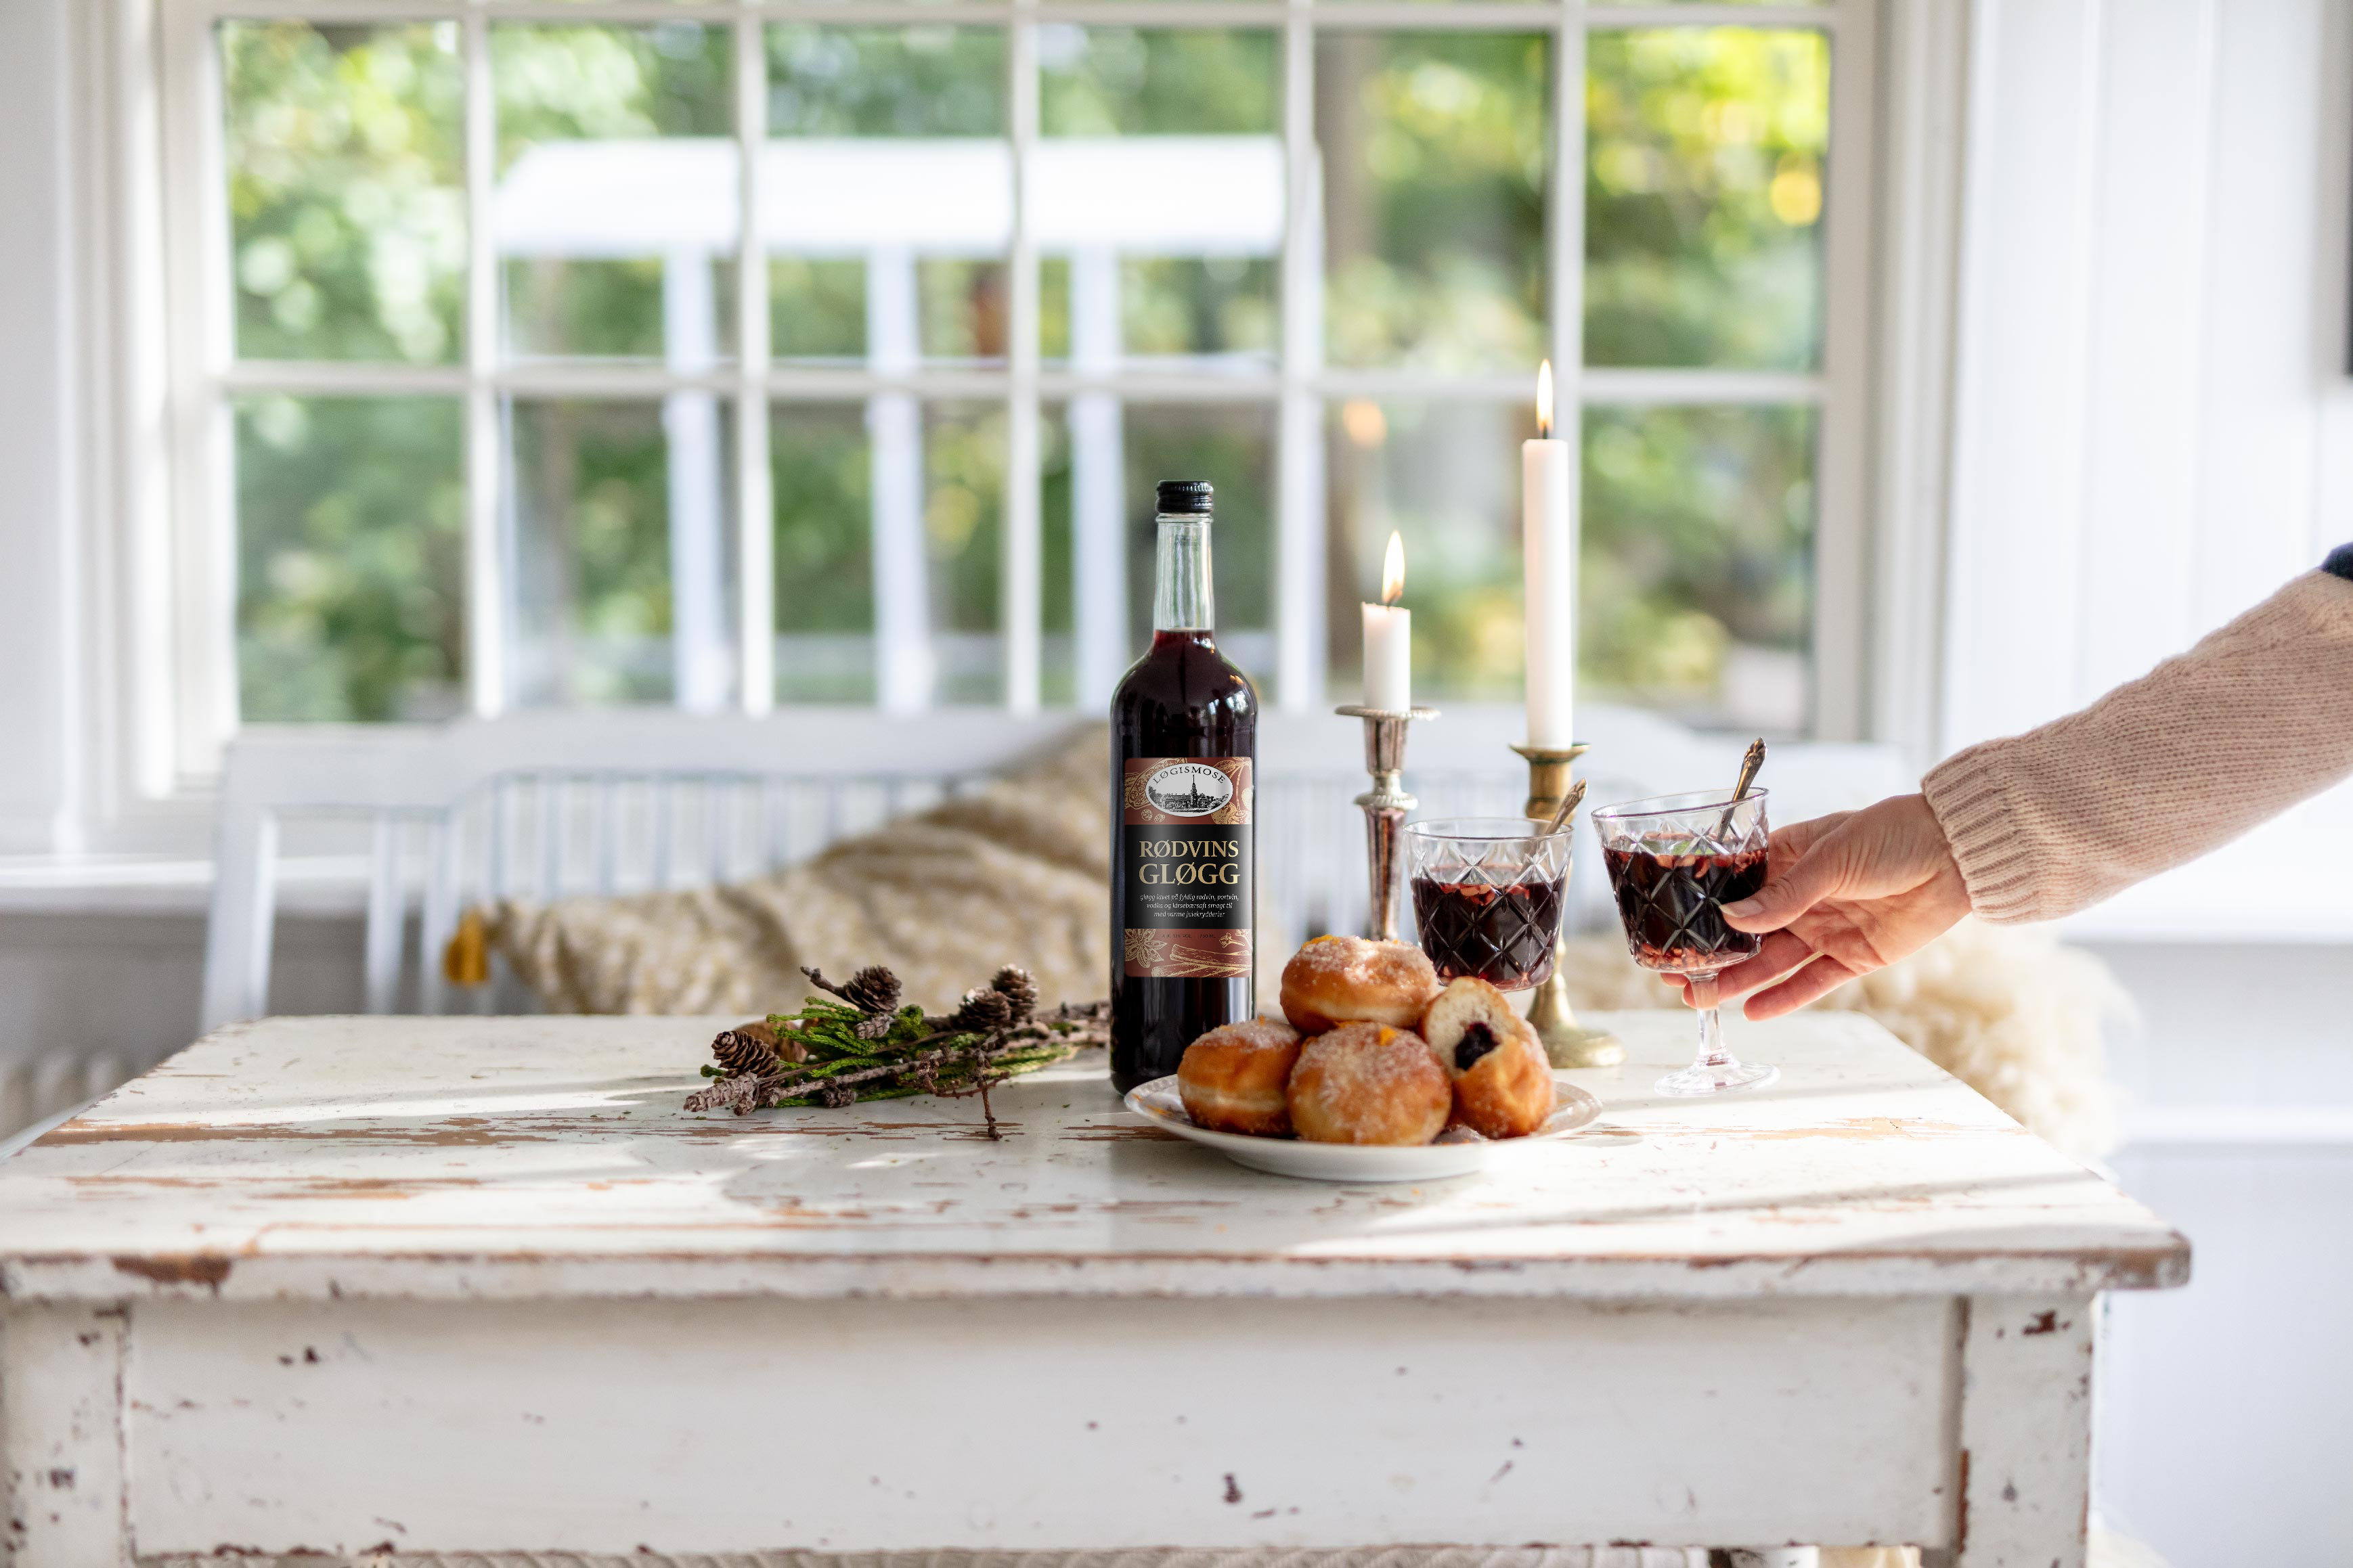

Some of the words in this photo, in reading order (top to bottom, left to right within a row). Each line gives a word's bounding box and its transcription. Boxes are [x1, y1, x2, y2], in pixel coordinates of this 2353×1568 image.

[1153, 766, 1225, 784] LØGISMOSE
[1139, 839, 1239, 858] RØDVINS
[1139, 861, 1241, 886] GLØGG
